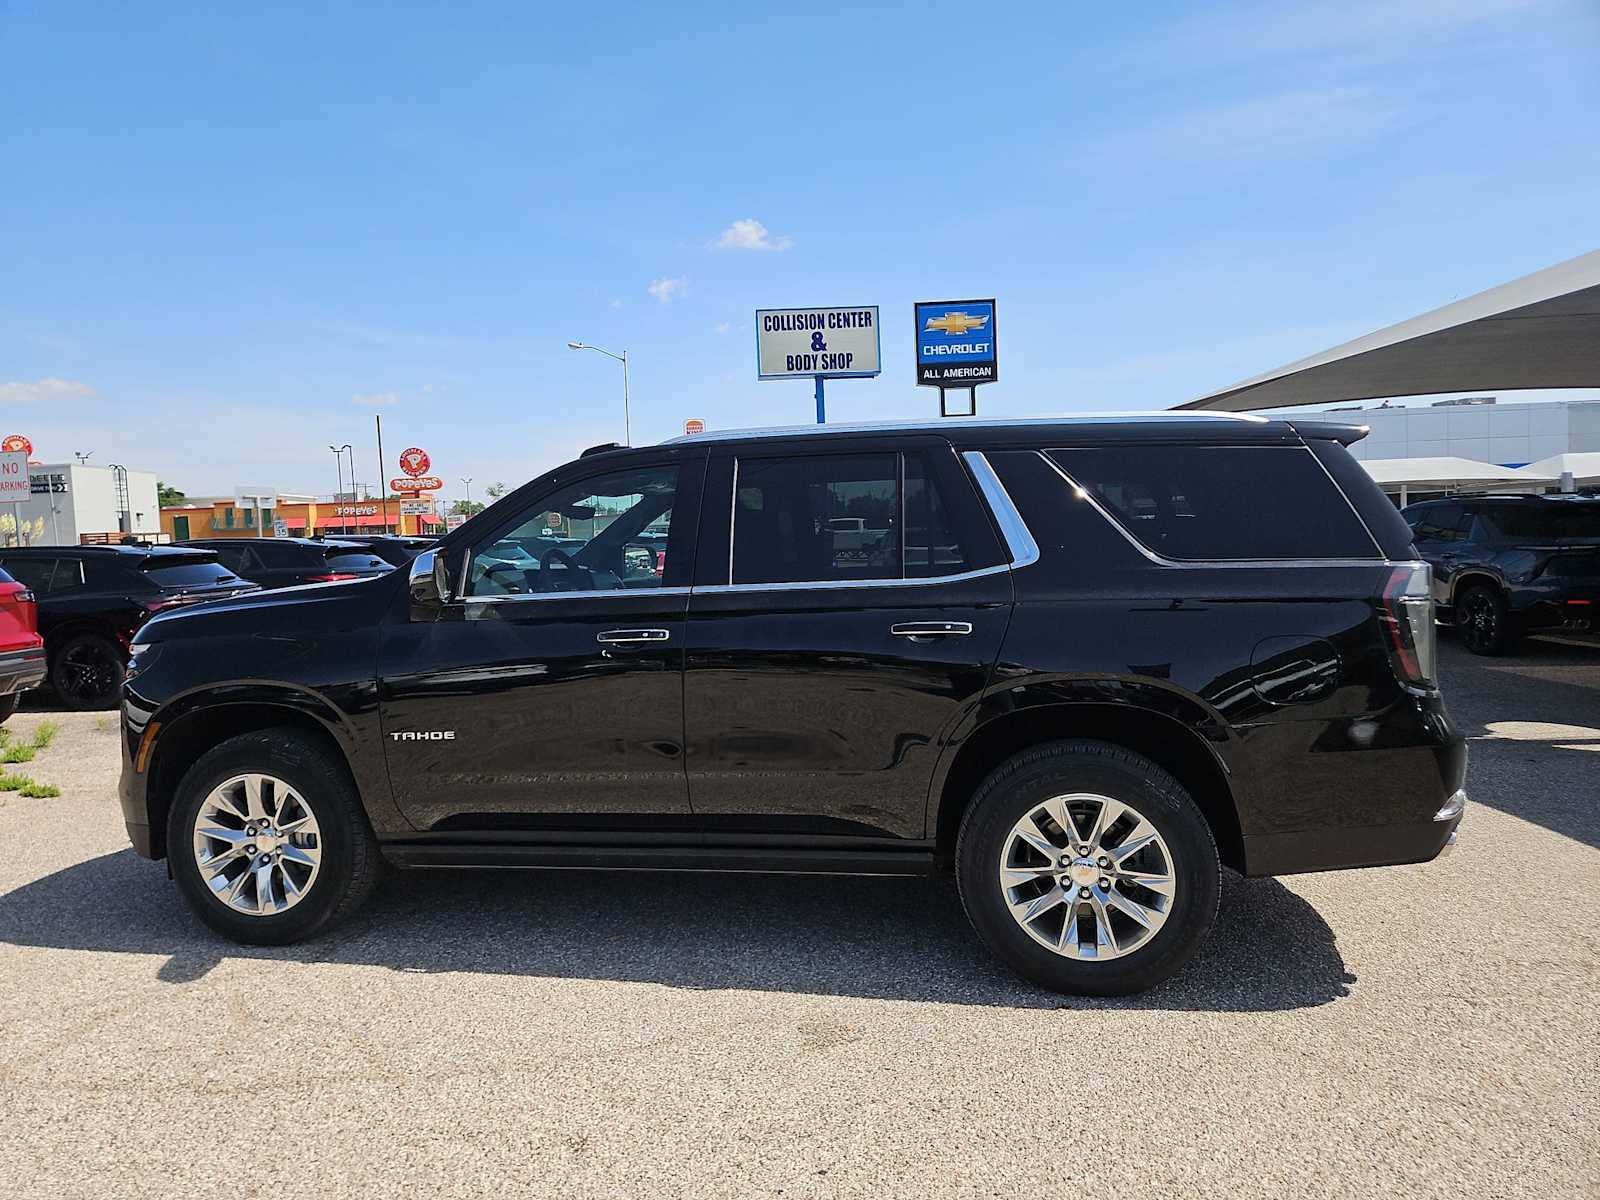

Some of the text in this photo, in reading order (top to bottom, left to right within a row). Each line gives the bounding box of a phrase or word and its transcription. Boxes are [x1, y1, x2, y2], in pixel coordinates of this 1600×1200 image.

[764, 311, 872, 332] COLLISION CENTER
[811, 331, 827, 352] &
[923, 343, 990, 356] CHEVROLET
[786, 353, 853, 371] BODY SHOP
[923, 367, 992, 379] ALL AMERICAN
[2, 463, 18, 474] NO
[0, 481, 28, 490] ARKING
[390, 731, 455, 740] TAHOE
